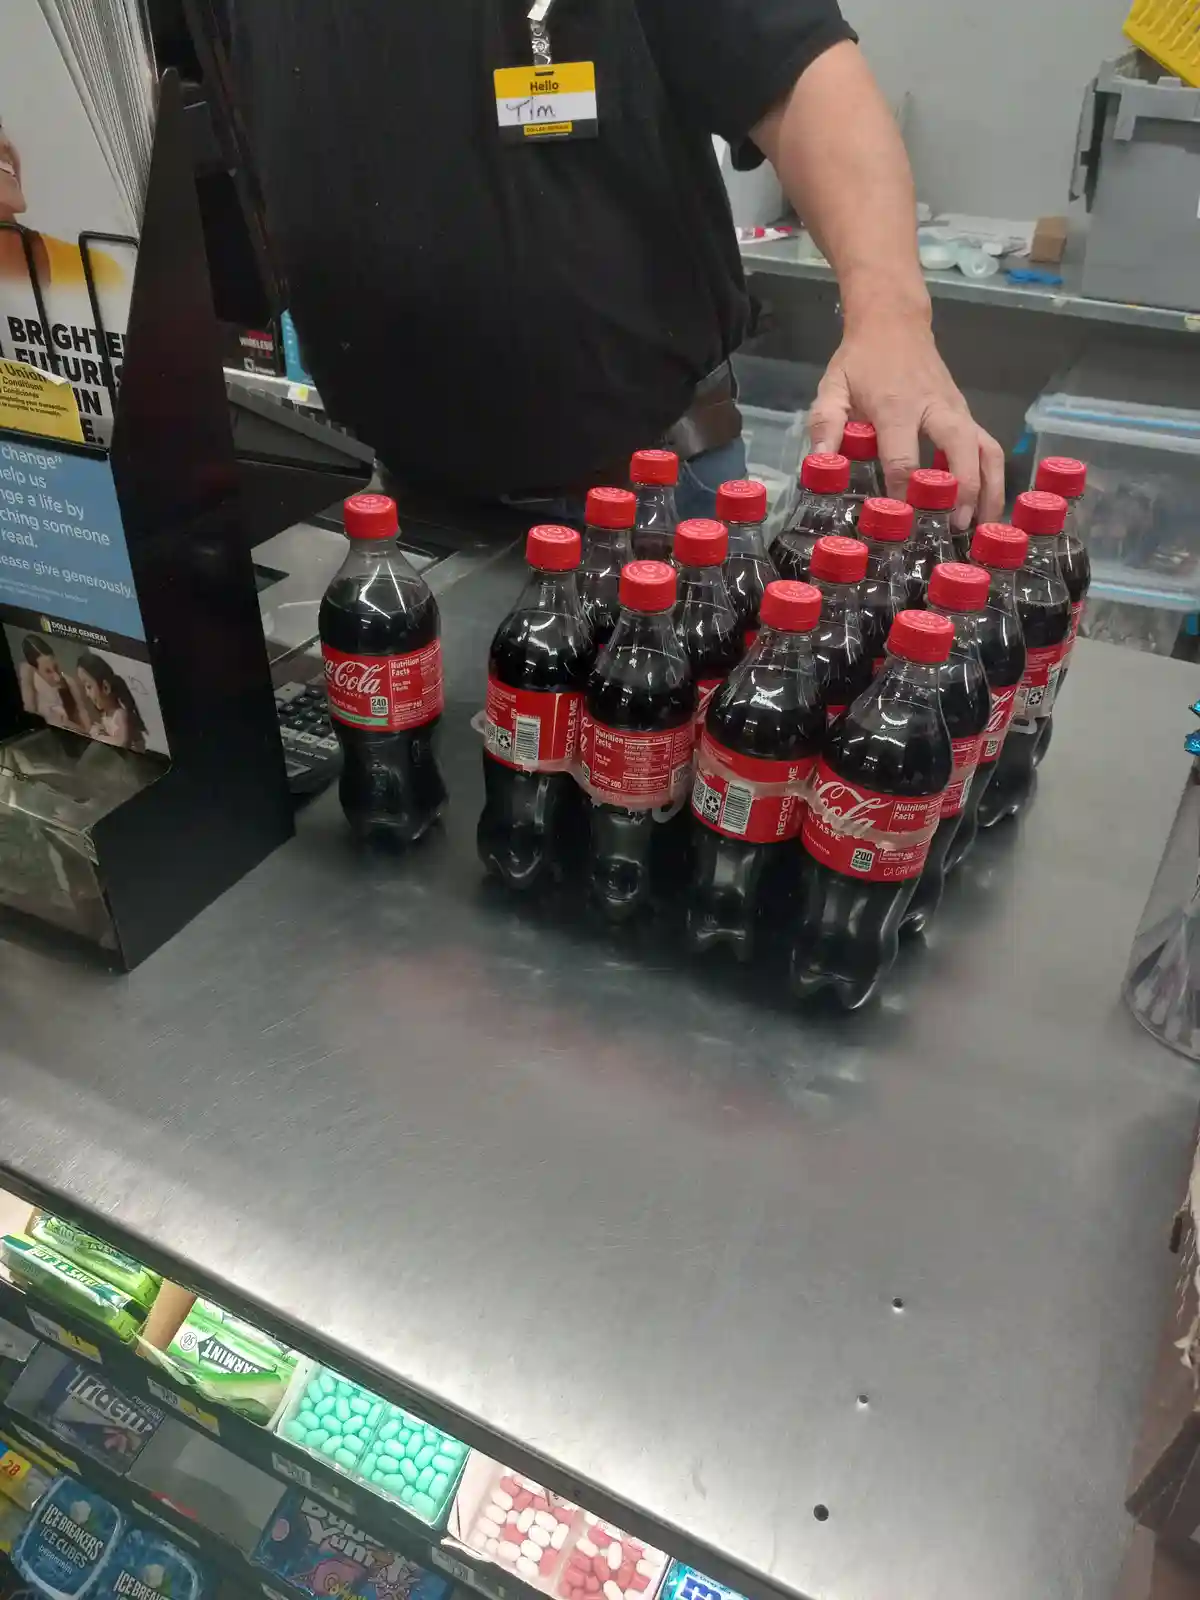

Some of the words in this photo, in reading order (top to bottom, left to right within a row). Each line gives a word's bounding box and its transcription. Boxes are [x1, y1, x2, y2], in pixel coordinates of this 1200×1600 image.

[530, 80, 559, 92] Hello
[7, 316, 126, 358] BRGHTE
[4, 363, 47, 384] Union
[29, 477, 47, 488] us
[28, 494, 37, 507] a
[39, 493, 63, 513] life
[66, 499, 84, 521] by
[0, 507, 39, 531] ching
[42, 518, 110, 546] someone
[1, 529, 38, 549] read.
[0, 554, 30, 570] ease
[33, 560, 60, 576] give
[51, 620, 78, 634] DOLLAR
[78, 628, 109, 643] GENERAL
[391, 658, 420, 669] Nutrition
[391, 668, 411, 677] Facts
[371, 698, 387, 707] 240
[568, 697, 579, 717] ME
[595, 727, 624, 745] Nutrition
[595, 735, 612, 749] Facts
[776, 795, 792, 837] RECYCL
[893, 811, 916, 820] Facts
[895, 802, 929, 812] Nutrition
[854, 849, 873, 862] 200
[201, 1339, 259, 1374] ARMINT.
[3, 1459, 21, 1477] 28
[41, 1503, 61, 1529] ICE
[56, 1511, 105, 1561] BREAKERS
[39, 1526, 57, 1546] ICE
[55, 1534, 89, 1569] CUBES
[113, 1569, 136, 1594] ICE
